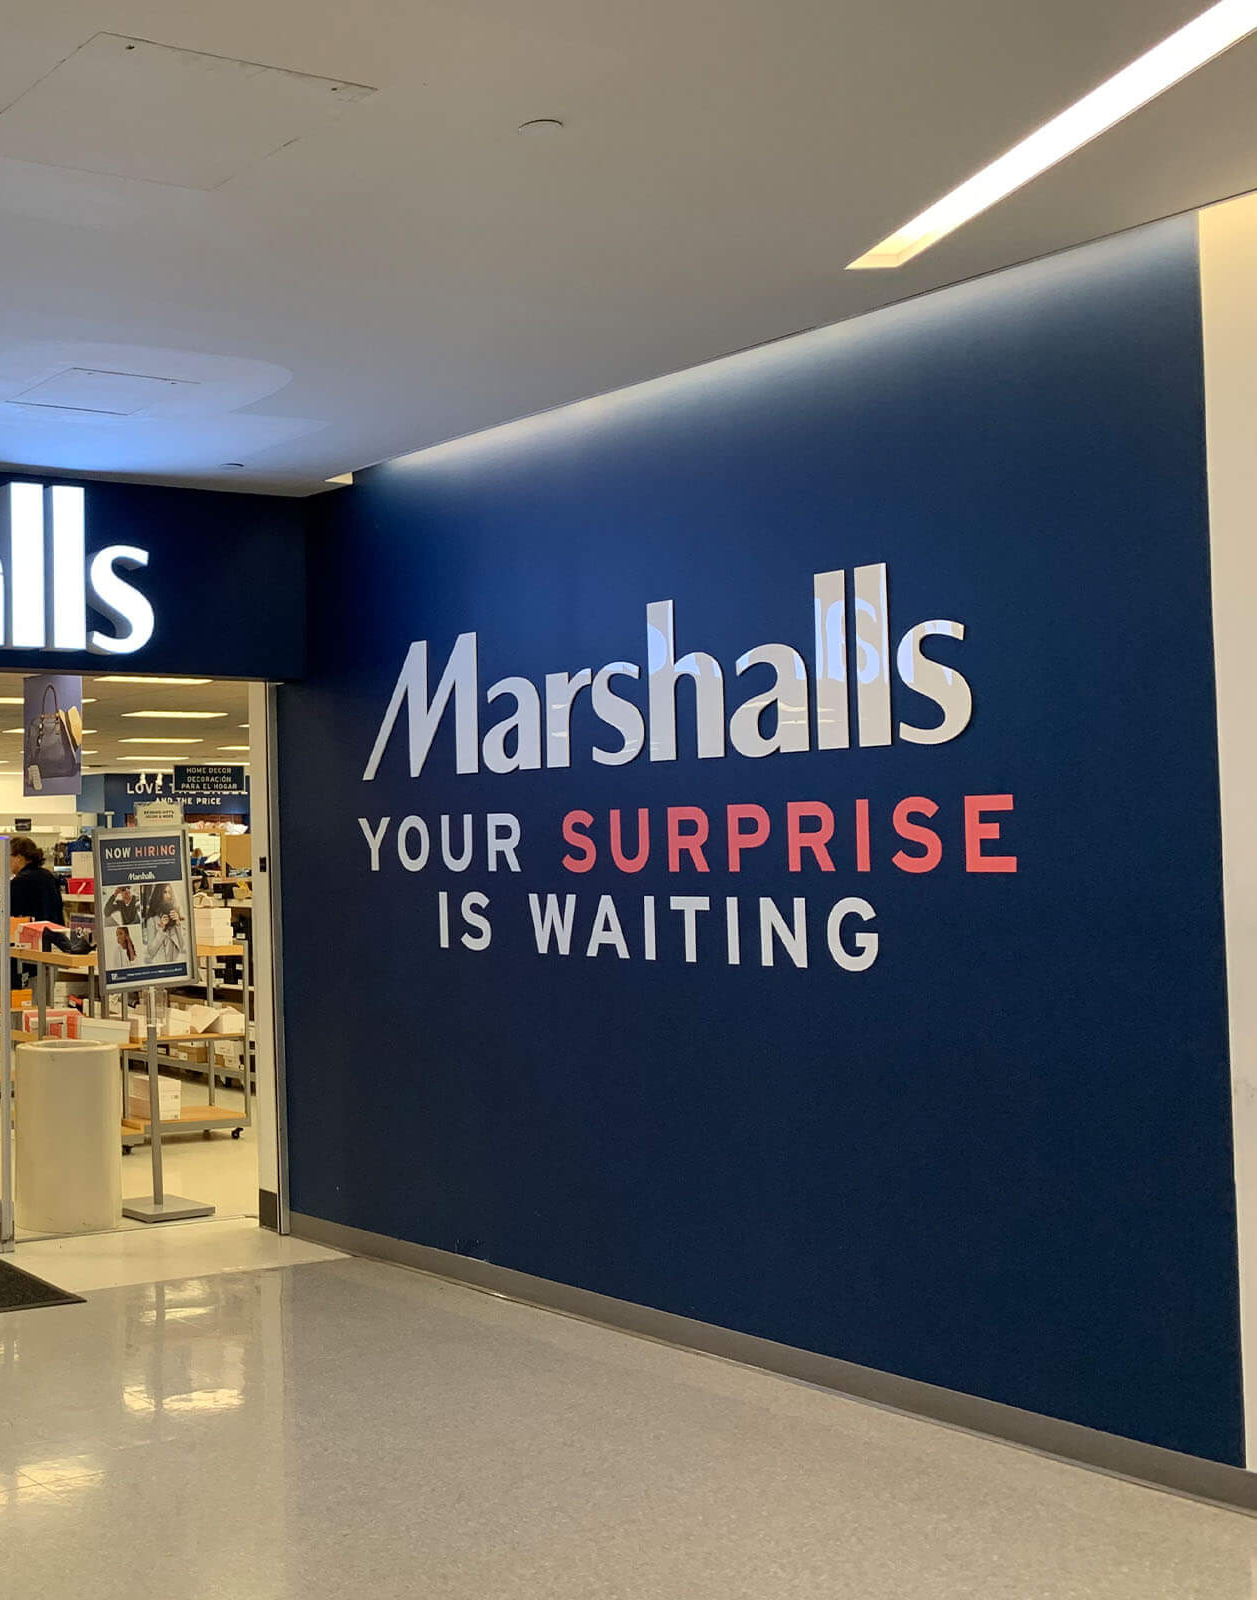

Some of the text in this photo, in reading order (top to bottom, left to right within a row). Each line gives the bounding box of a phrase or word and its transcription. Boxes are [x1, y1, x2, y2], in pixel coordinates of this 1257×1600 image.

[362, 562, 973, 781] Marshalls
[126, 783, 163, 795] LOVE
[176, 797, 193, 805] THE
[196, 797, 221, 805] PRICE
[105, 844, 176, 860] NOW HIRING
[358, 794, 1018, 873] YOUR SURPRISE
[438, 891, 880, 972] IS WAITING
